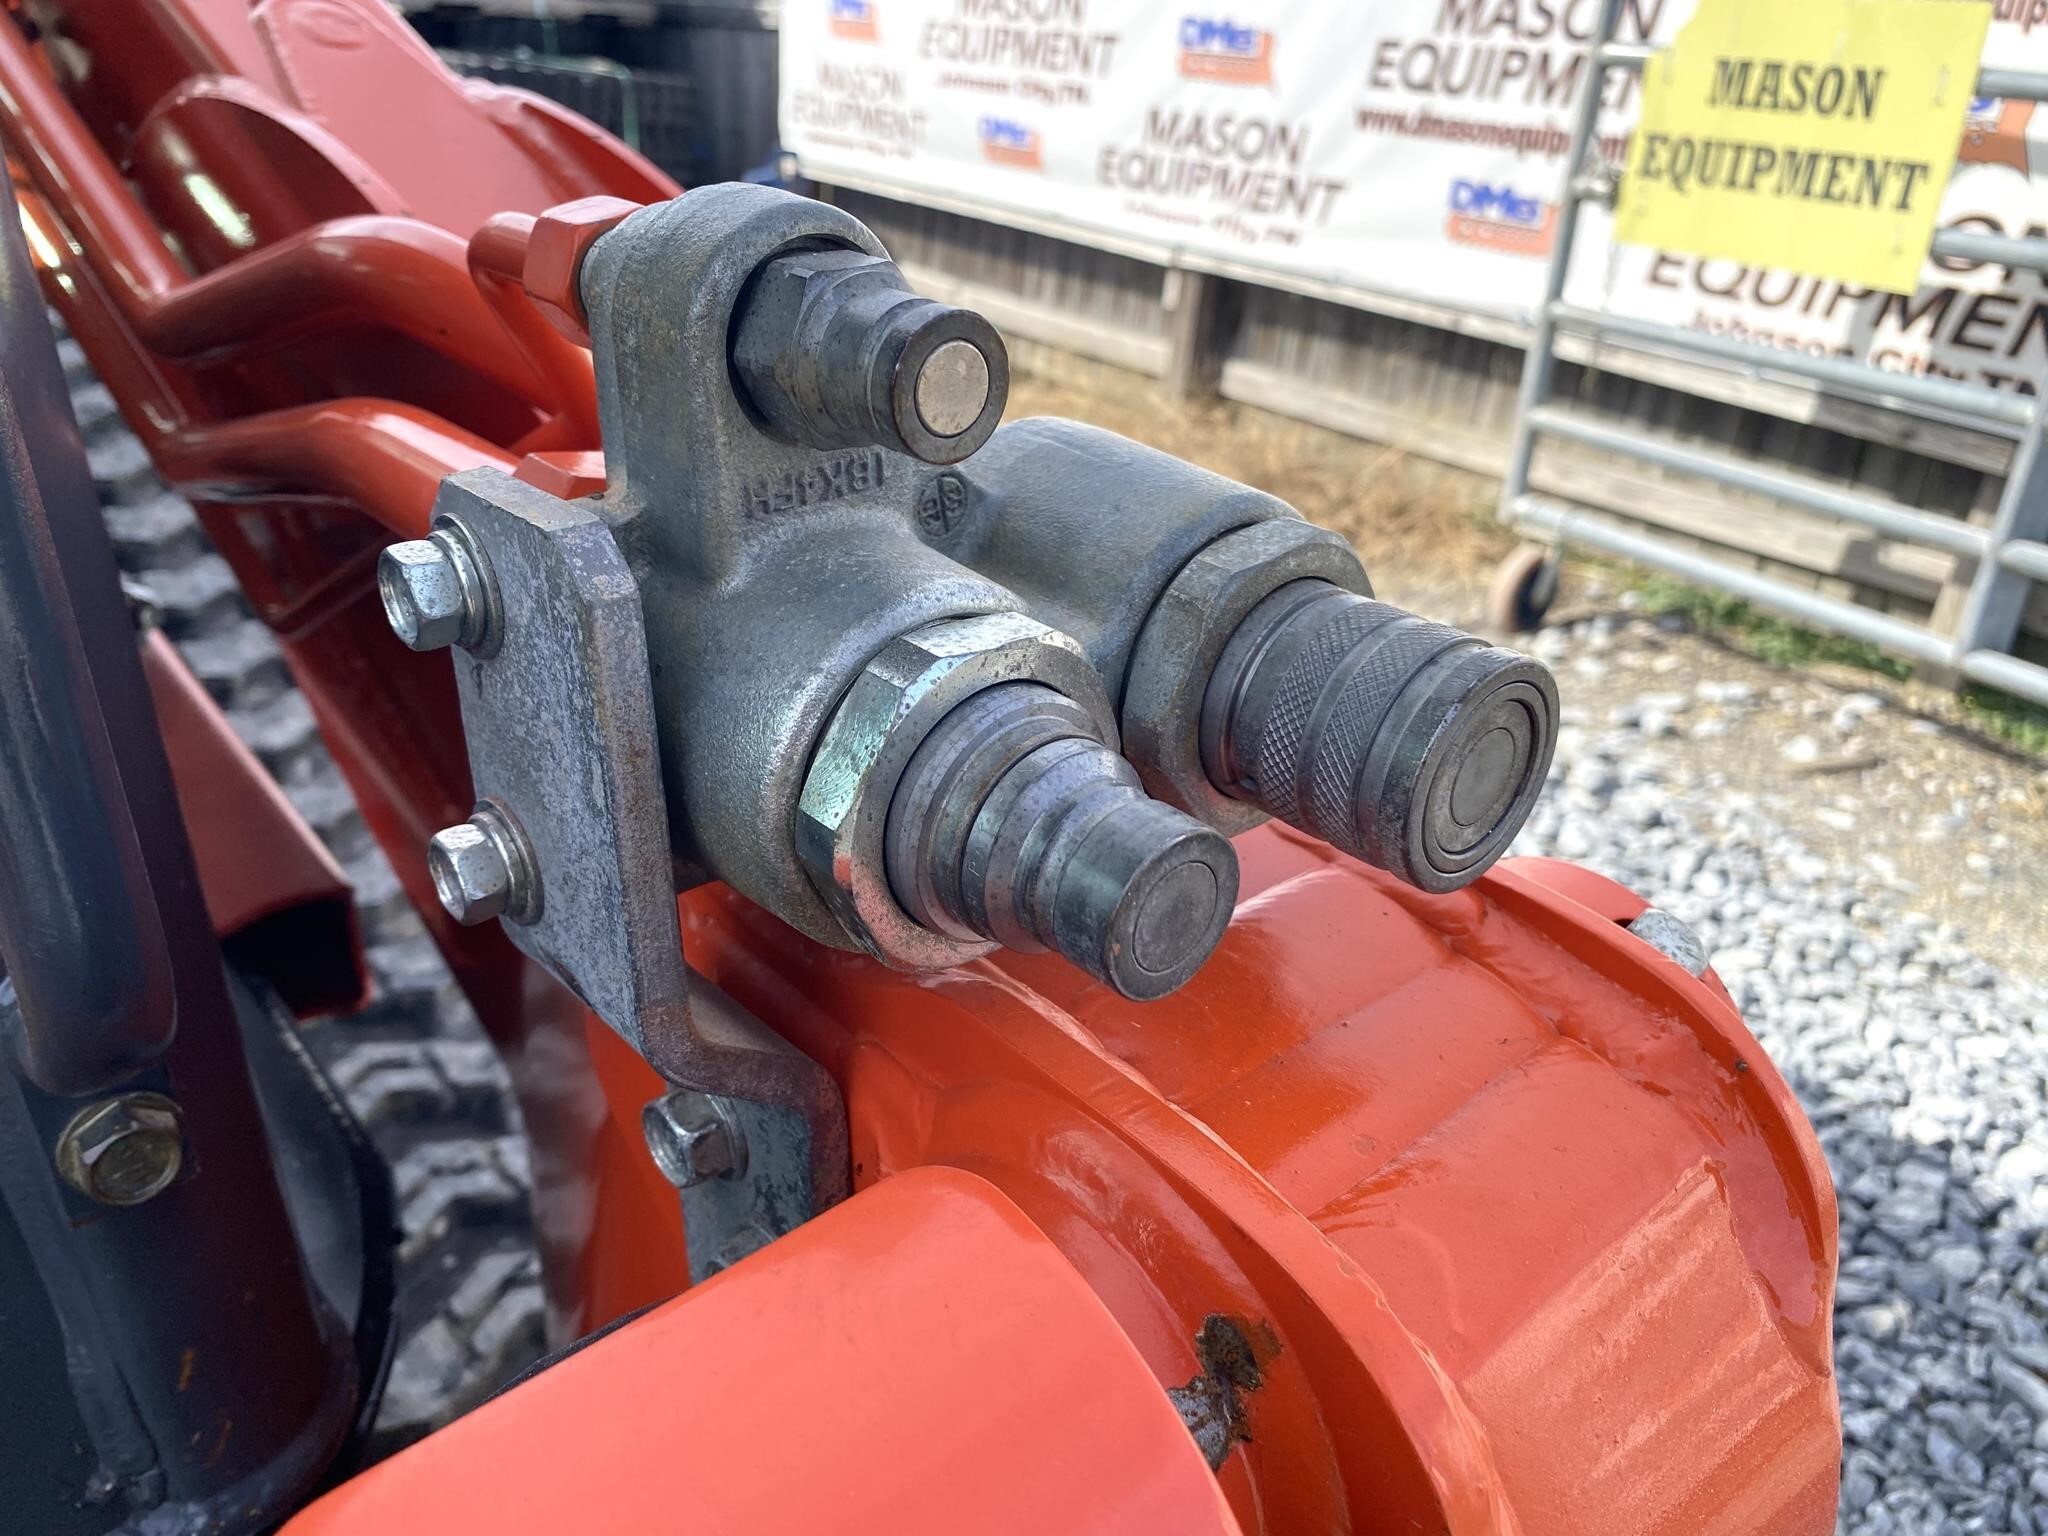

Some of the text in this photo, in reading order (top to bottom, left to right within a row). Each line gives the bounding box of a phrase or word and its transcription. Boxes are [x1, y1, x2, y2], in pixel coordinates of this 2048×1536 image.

[922, 19, 1120, 76] EQUIPMENT
[1709, 57, 1887, 120] MASON
[1147, 107, 1309, 165] MASON
[1098, 147, 1350, 226] EQUIPMENT
[1640, 133, 1931, 211] EQUIPMENT
